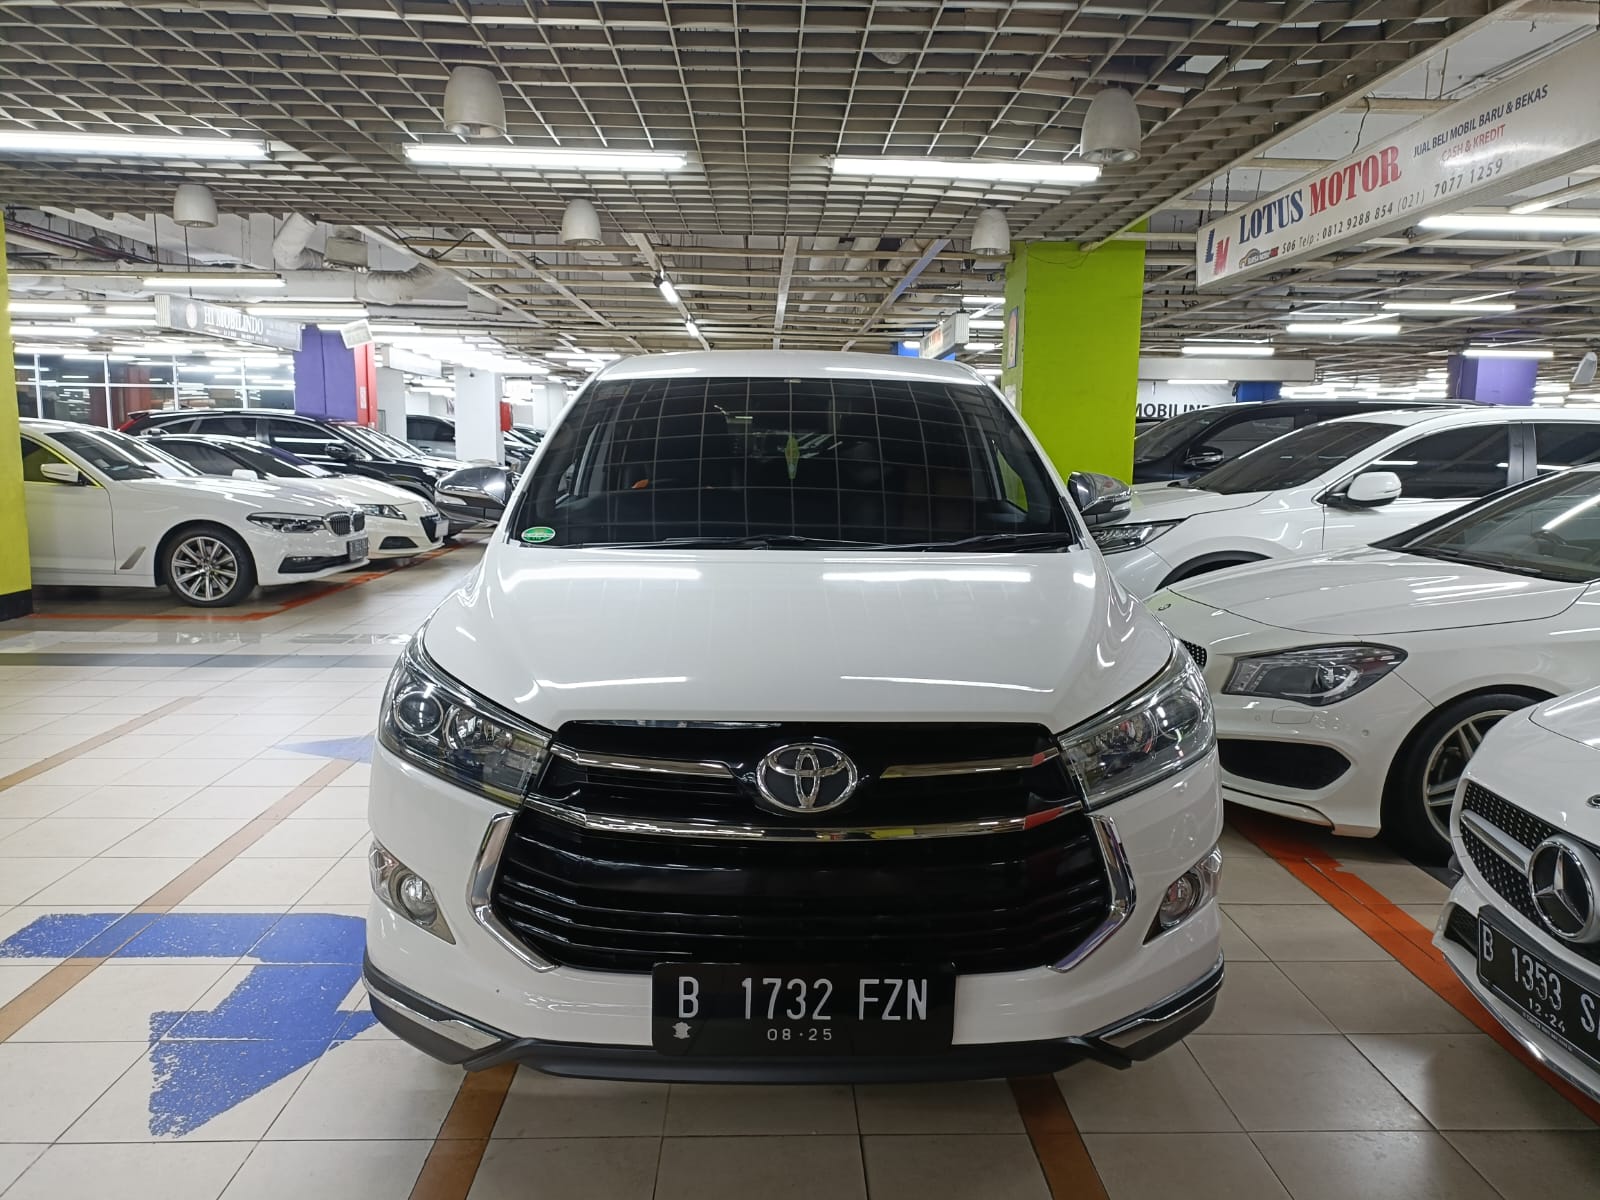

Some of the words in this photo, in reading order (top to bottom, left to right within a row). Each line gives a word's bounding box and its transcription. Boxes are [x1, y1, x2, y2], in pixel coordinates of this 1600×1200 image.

[1412, 143, 1431, 158] JUAL
[1432, 130, 1449, 149] BELI
[1449, 118, 1477, 141] MOBIL
[1478, 105, 1505, 128] BARU
[1505, 101, 1514, 115] &
[1514, 84, 1549, 111] BEKAS
[1441, 145, 1465, 163] CASH
[1464, 140, 1473, 153] &
[1473, 124, 1506, 150] KREDIT
[1238, 188, 1304, 245] LOTUS
[1309, 145, 1402, 217] MOTOR
[1322, 220, 1343, 240] 0812
[1346, 210, 1370, 230] 9288
[1374, 202, 1393, 220] 854
[1397, 189, 1426, 212] (021)
[1433, 174, 1464, 198] 7077
[1470, 158, 1503, 184] 1259
[677, 976, 699, 1019] B
[741, 977, 833, 1021] 1732
[858, 978, 928, 1021] FZN
[1482, 924, 1494, 962] B
[1511, 946, 1562, 1011] 1353
[1580, 993, 1600, 1041] S
